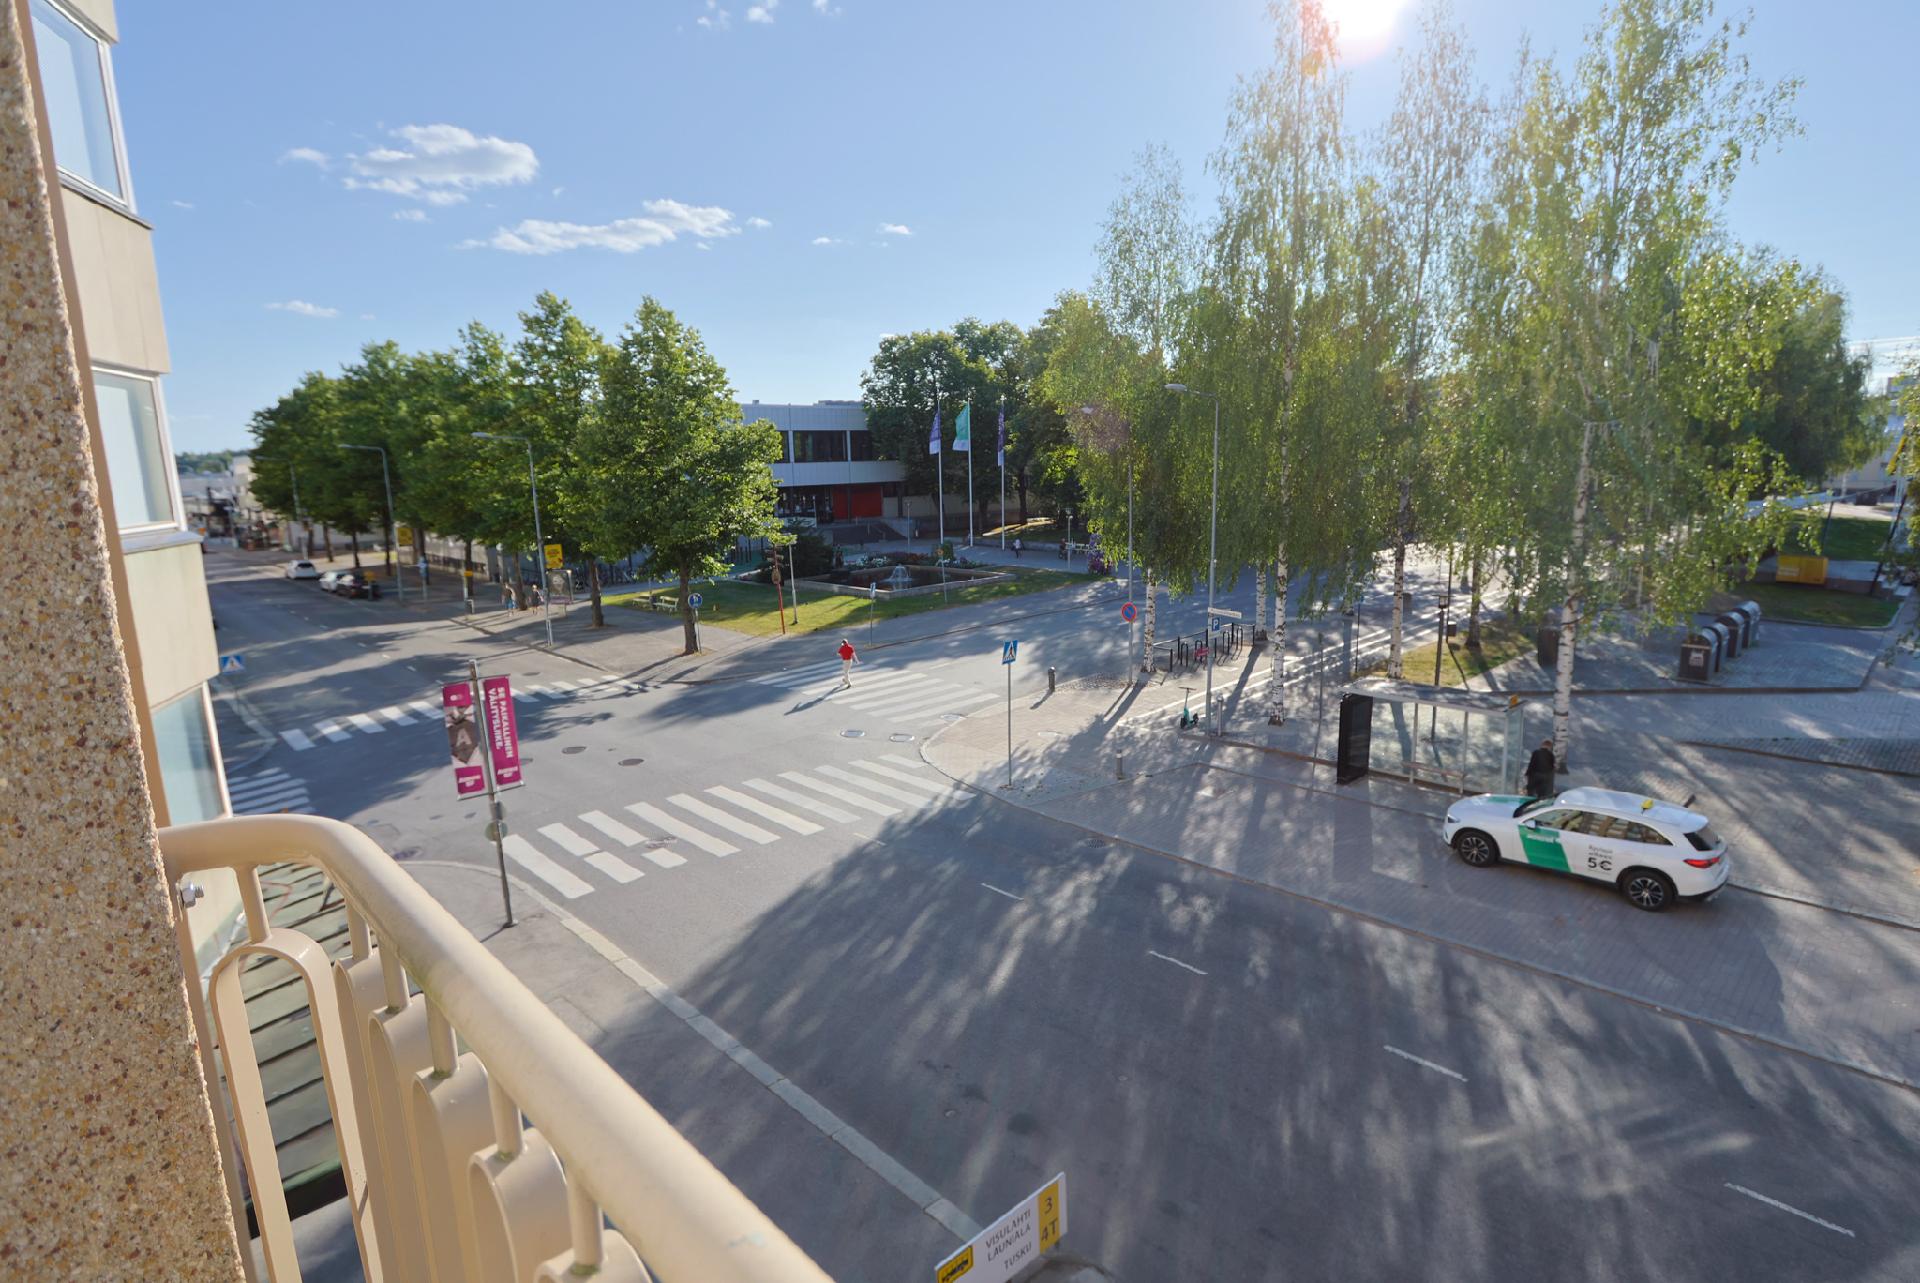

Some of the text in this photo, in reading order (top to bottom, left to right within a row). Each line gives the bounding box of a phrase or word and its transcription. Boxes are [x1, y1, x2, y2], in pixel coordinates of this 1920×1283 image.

[1213, 619, 1219, 630] P
[497, 686, 505, 699] SE
[499, 700, 514, 758] PAIKALLINEN
[1044, 1197, 1053, 1215] 3
[985, 1209, 1031, 1249] VISULAHTI
[987, 1224, 1032, 1262] LAUNIALA
[1004, 1242, 1032, 1270] TUSKU
